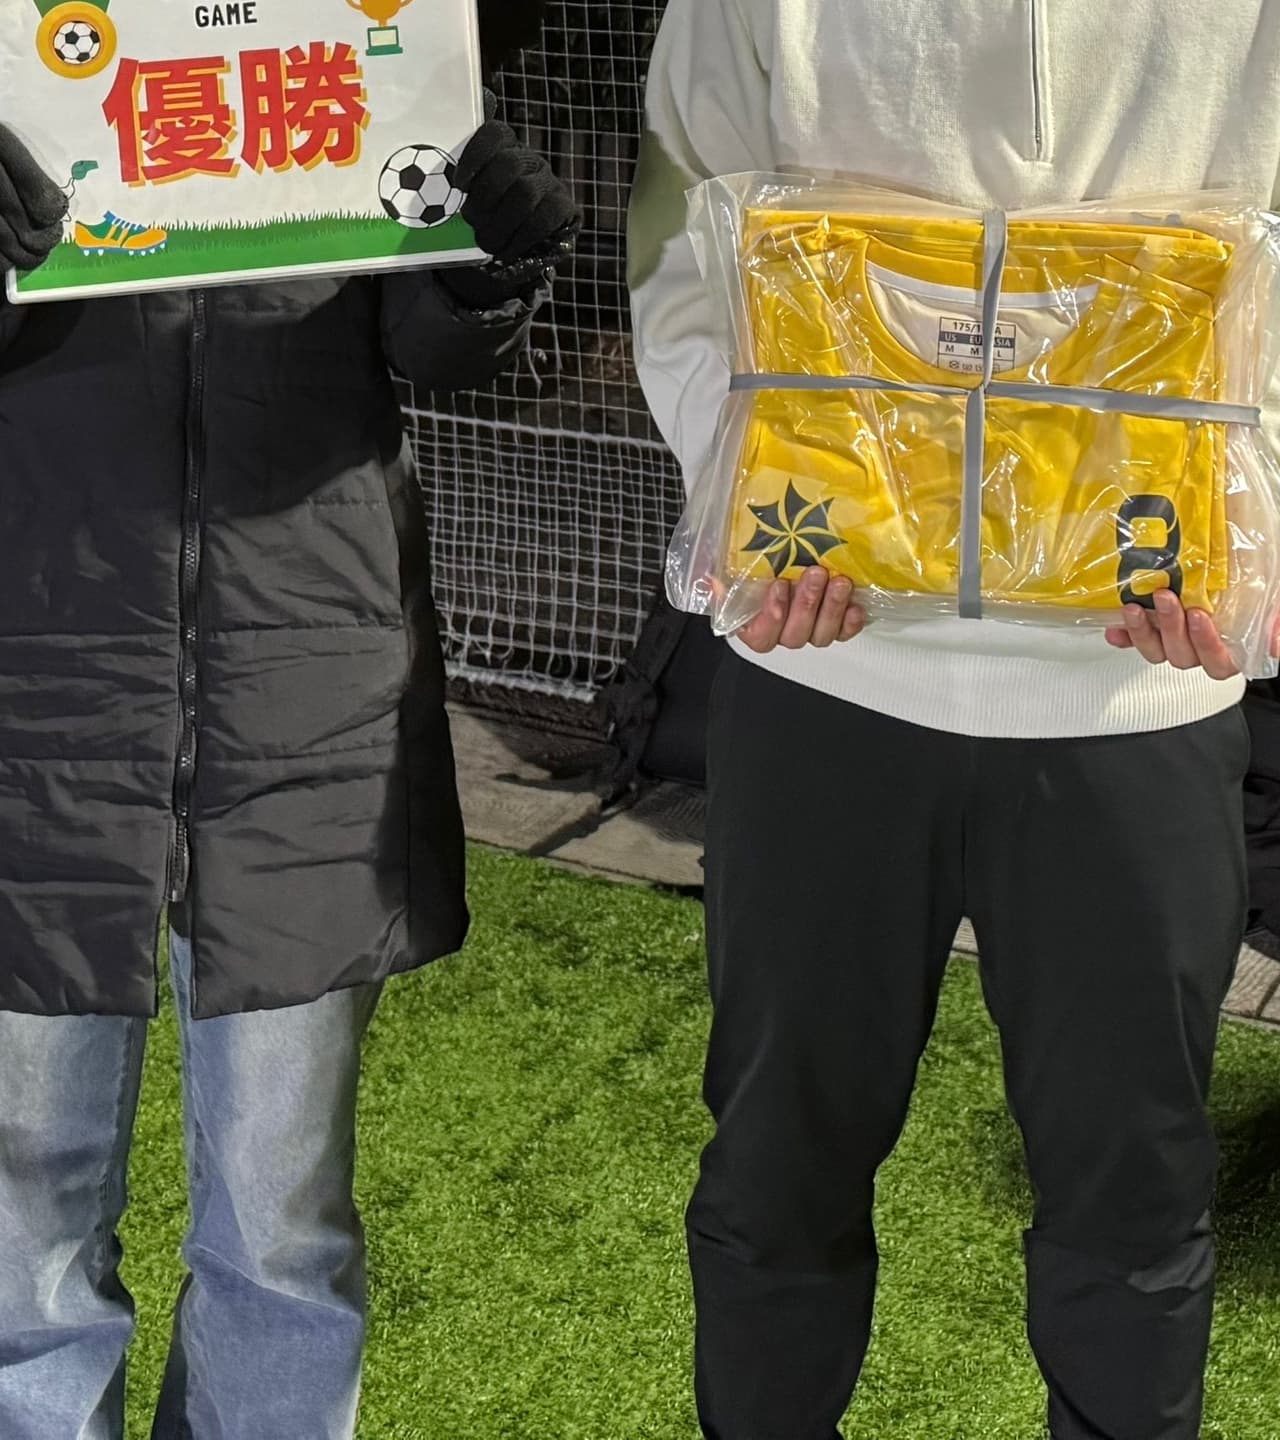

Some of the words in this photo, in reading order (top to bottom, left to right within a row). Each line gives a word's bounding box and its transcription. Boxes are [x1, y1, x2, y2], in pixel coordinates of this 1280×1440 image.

[195, 1, 258, 28] GAME
[102, 40, 370, 187] 優勝
[944, 333, 957, 341] US
[969, 335, 981, 345] EU
[945, 344, 955, 353] M
[970, 347, 980, 356] M
[997, 350, 1002, 358] L
